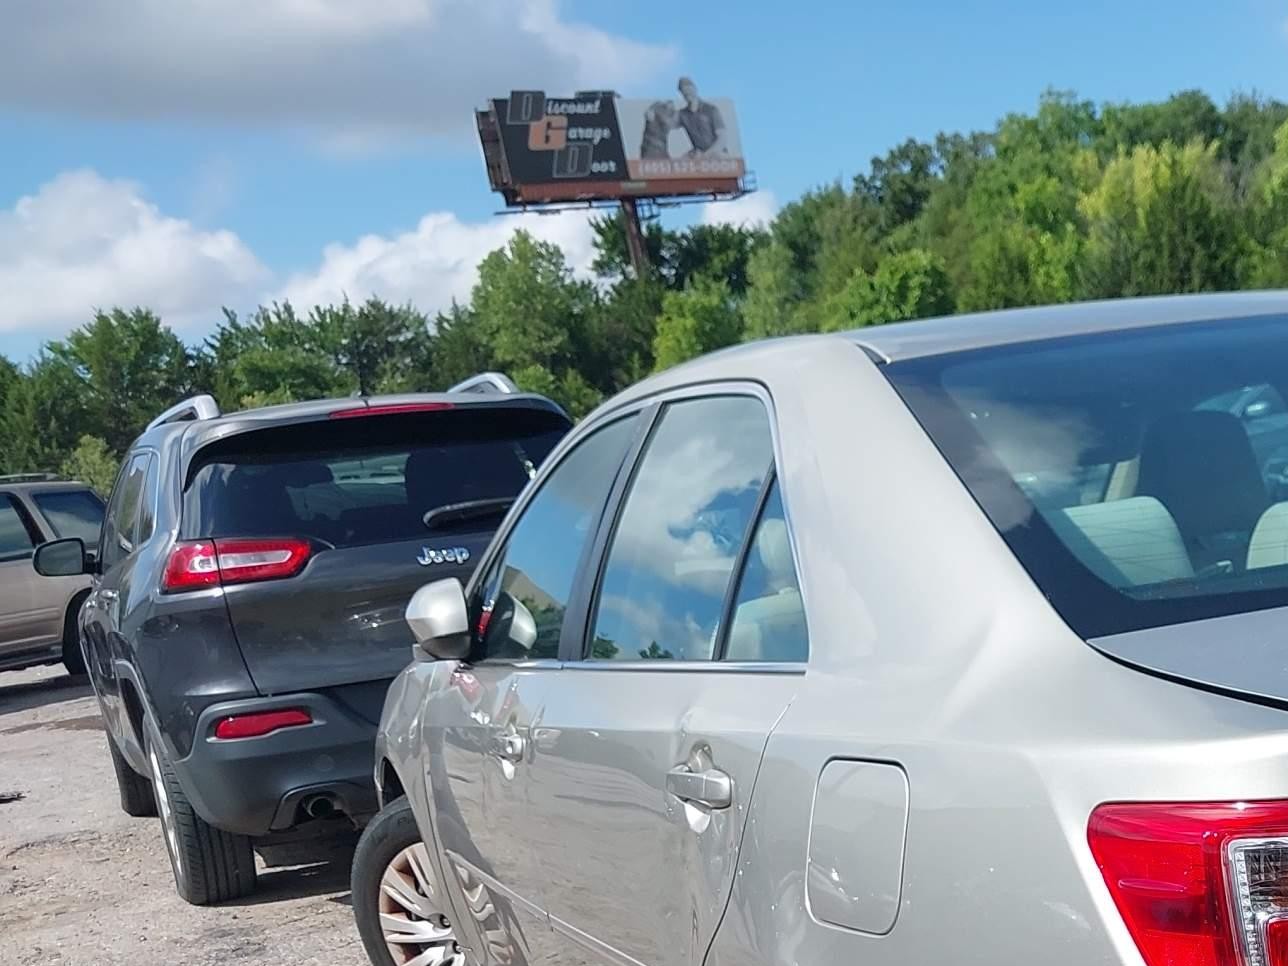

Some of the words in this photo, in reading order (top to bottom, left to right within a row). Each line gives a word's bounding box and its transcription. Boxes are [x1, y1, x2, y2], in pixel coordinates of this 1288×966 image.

[506, 91, 601, 125] Discount
[528, 116, 612, 151] Garage
[552, 142, 617, 178] Door
[416, 546, 470, 565] Jeep
